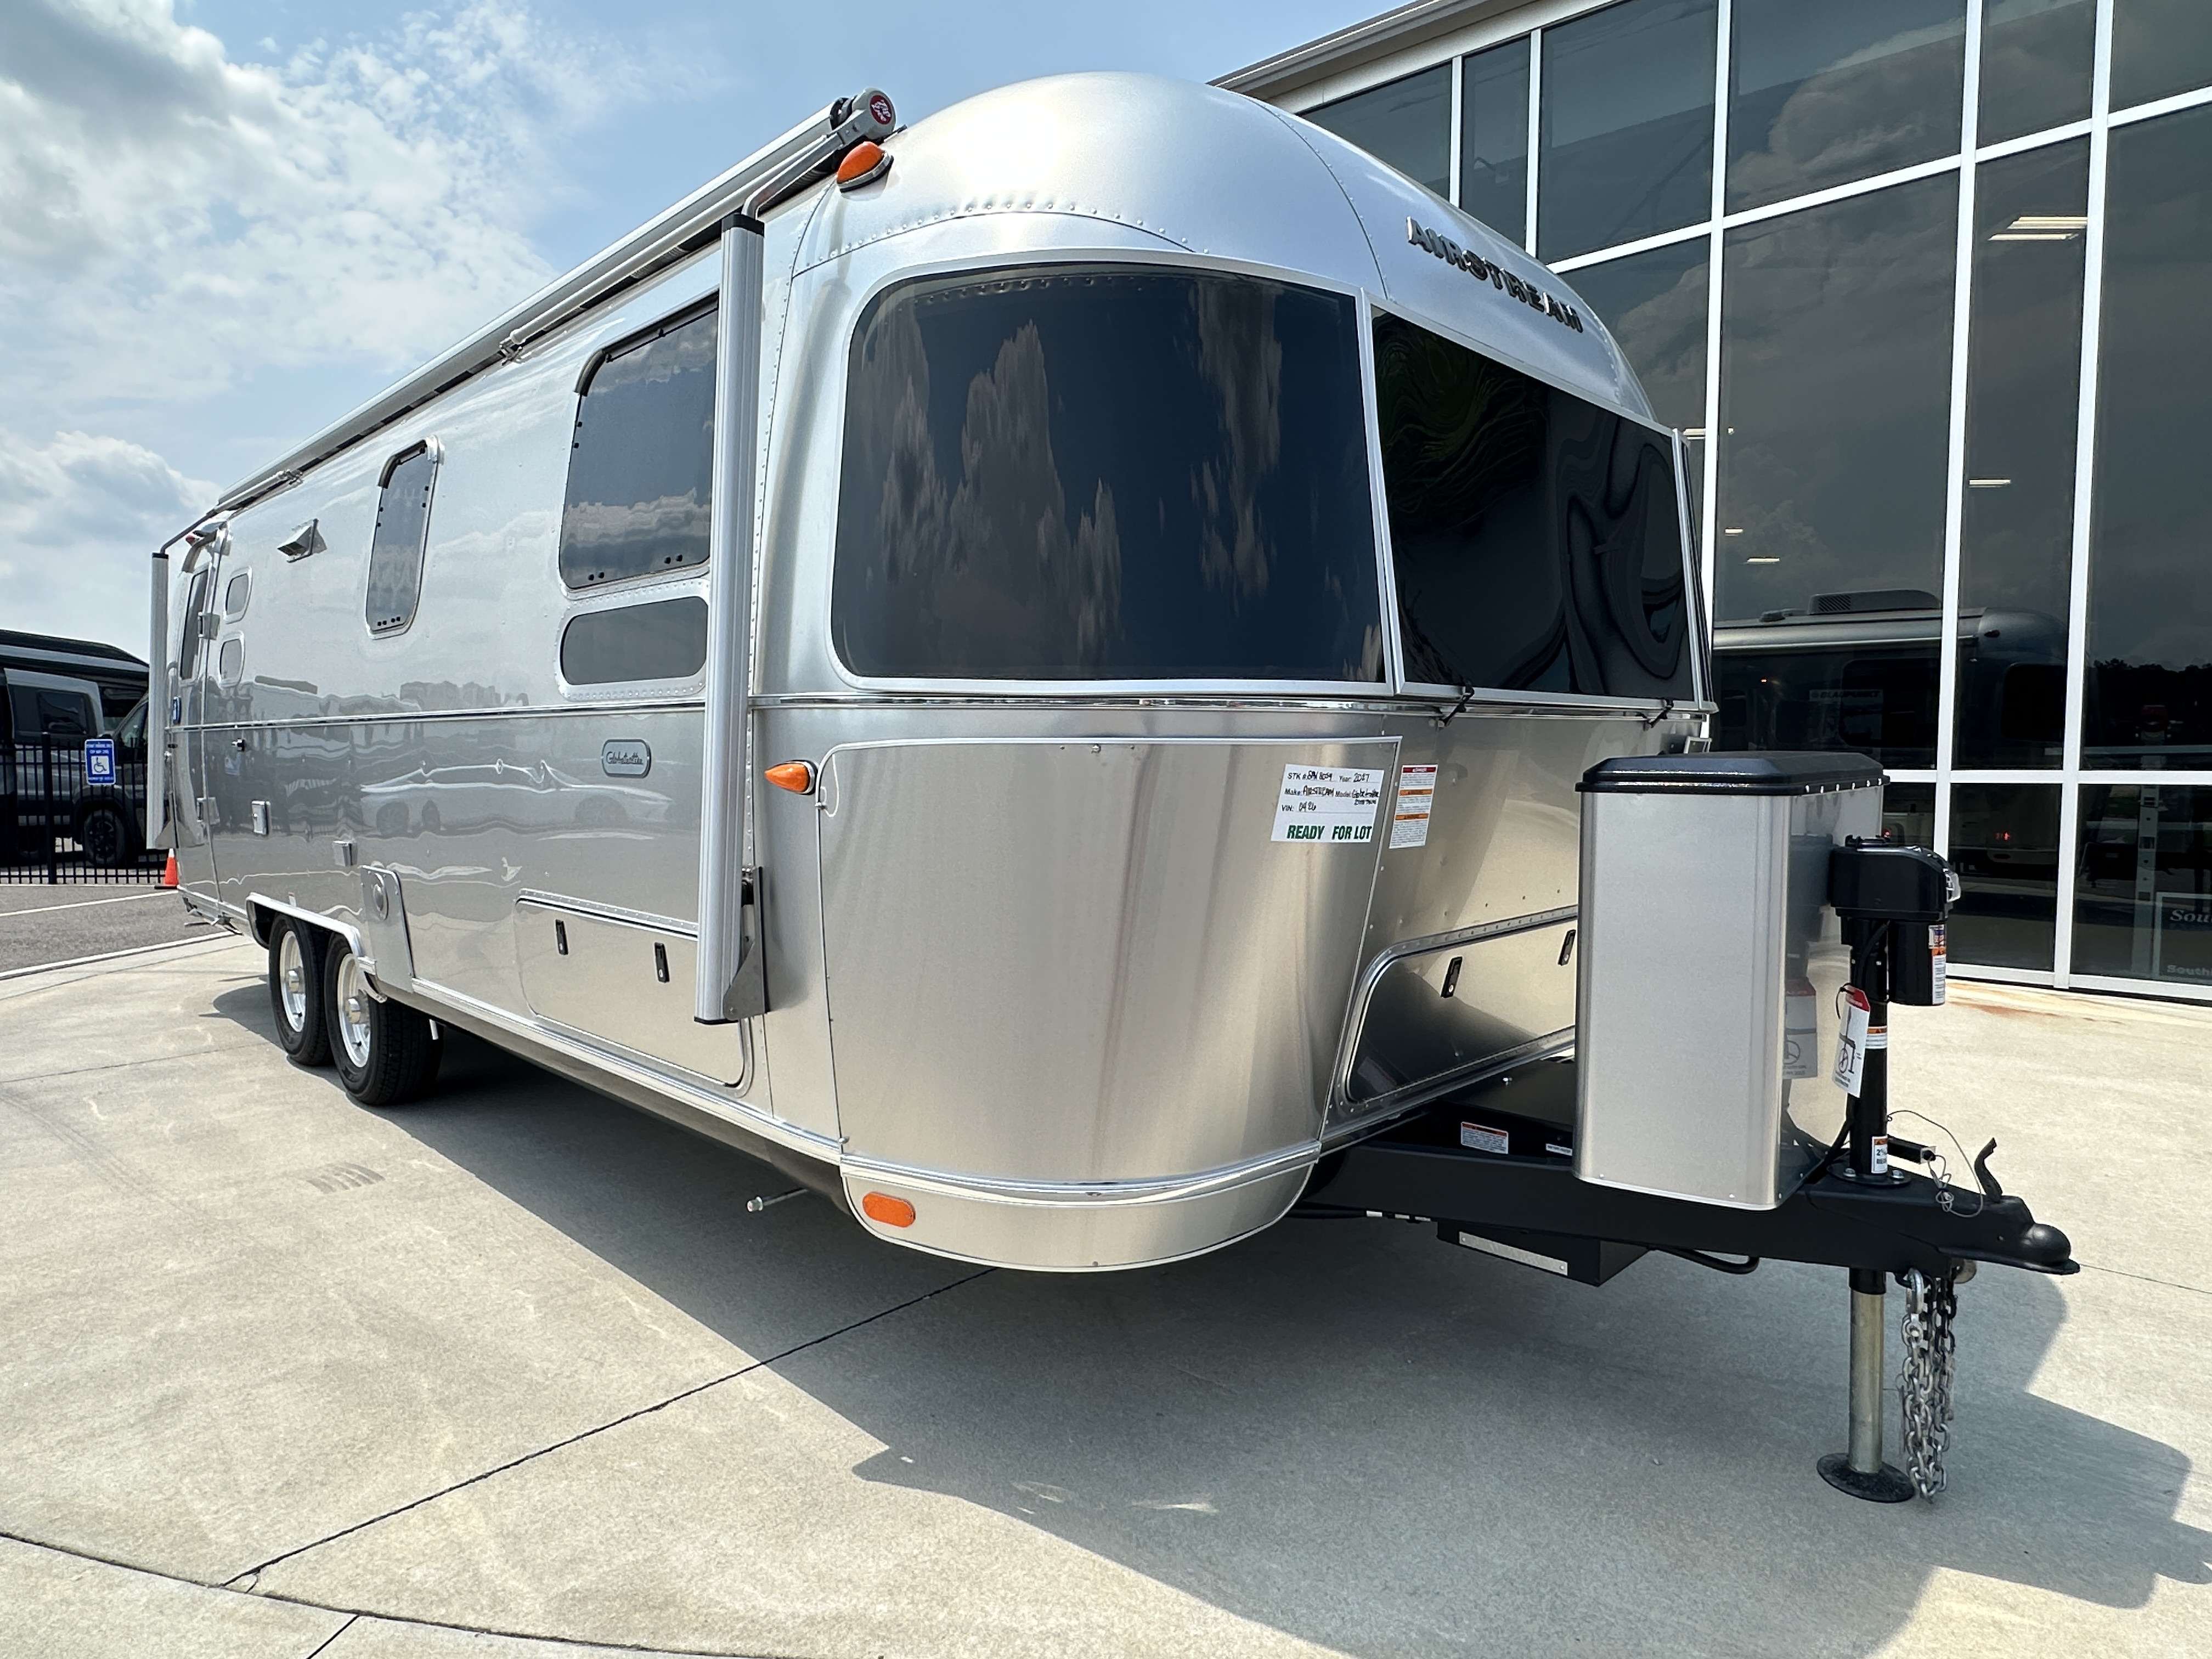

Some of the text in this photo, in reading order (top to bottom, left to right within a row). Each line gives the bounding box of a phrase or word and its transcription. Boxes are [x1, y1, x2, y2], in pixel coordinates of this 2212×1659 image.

[1406, 216, 1584, 334] AIRSTREAM
[1286, 825, 1372, 840] READY FOR LOT
[2170, 909, 2212, 923] Sou
[2167, 964, 2212, 976] South
